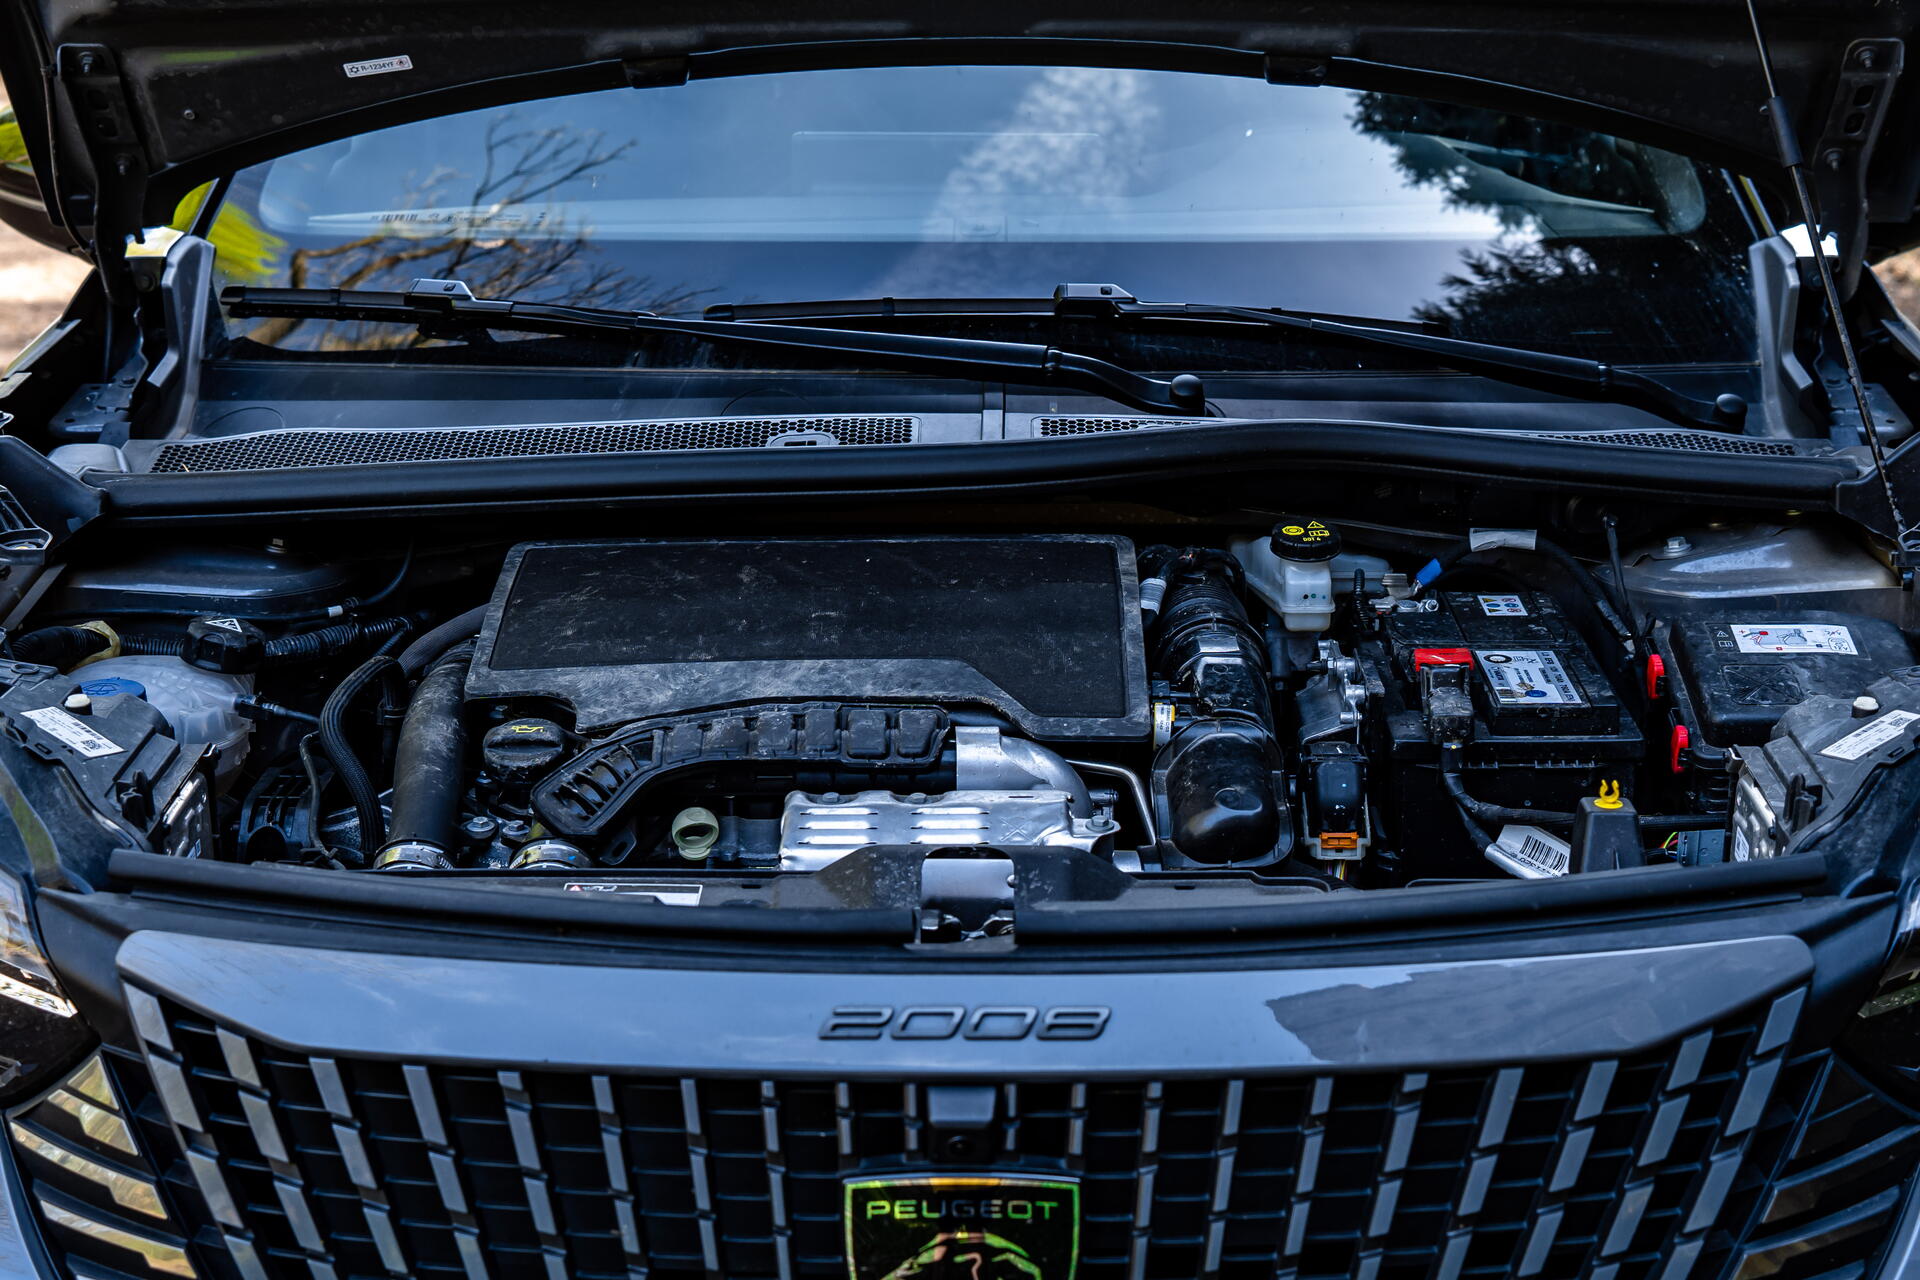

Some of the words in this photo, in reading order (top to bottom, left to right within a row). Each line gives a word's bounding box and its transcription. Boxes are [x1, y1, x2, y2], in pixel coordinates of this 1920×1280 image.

[361, 61, 394, 72] R-1234YF
[818, 1005, 1112, 1041] 2008
[866, 1200, 1059, 1221] PEUGEOT
